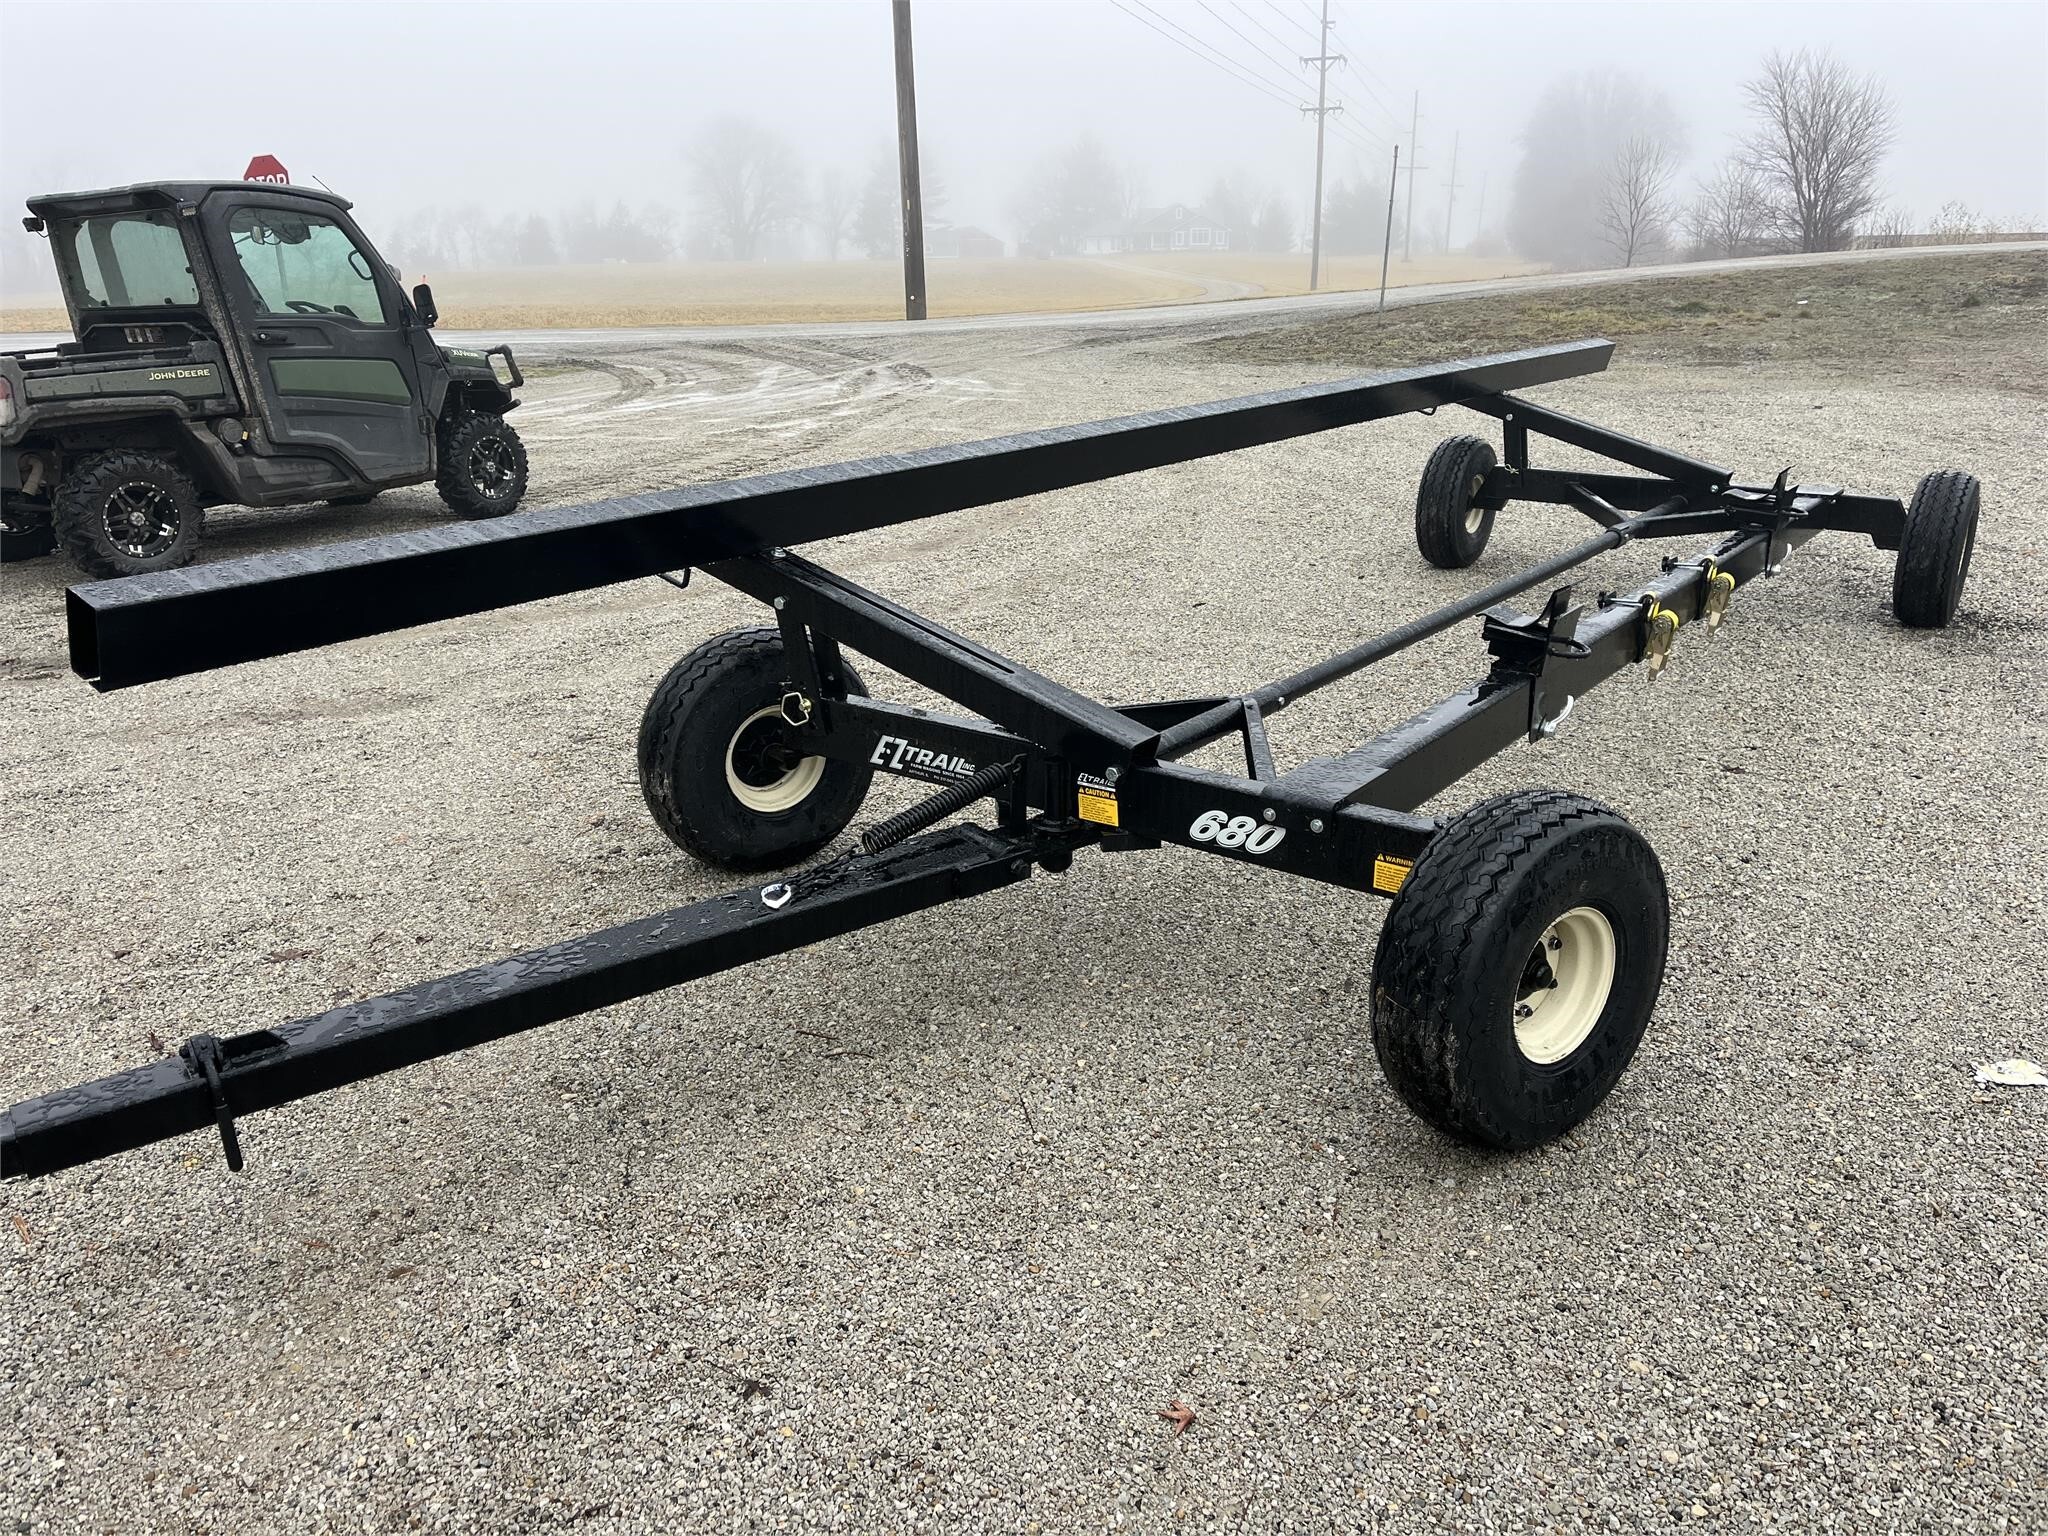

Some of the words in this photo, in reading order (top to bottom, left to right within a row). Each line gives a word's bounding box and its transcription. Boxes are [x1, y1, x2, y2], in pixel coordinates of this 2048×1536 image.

[247, 173, 287, 184] OP
[149, 371, 176, 380] JOHN
[176, 369, 211, 378] DEERE
[904, 745, 974, 776] TRAIL
[1085, 787, 1110, 798] CAUTION
[1189, 810, 1287, 854] 680
[1385, 855, 1414, 866] WARNIN
